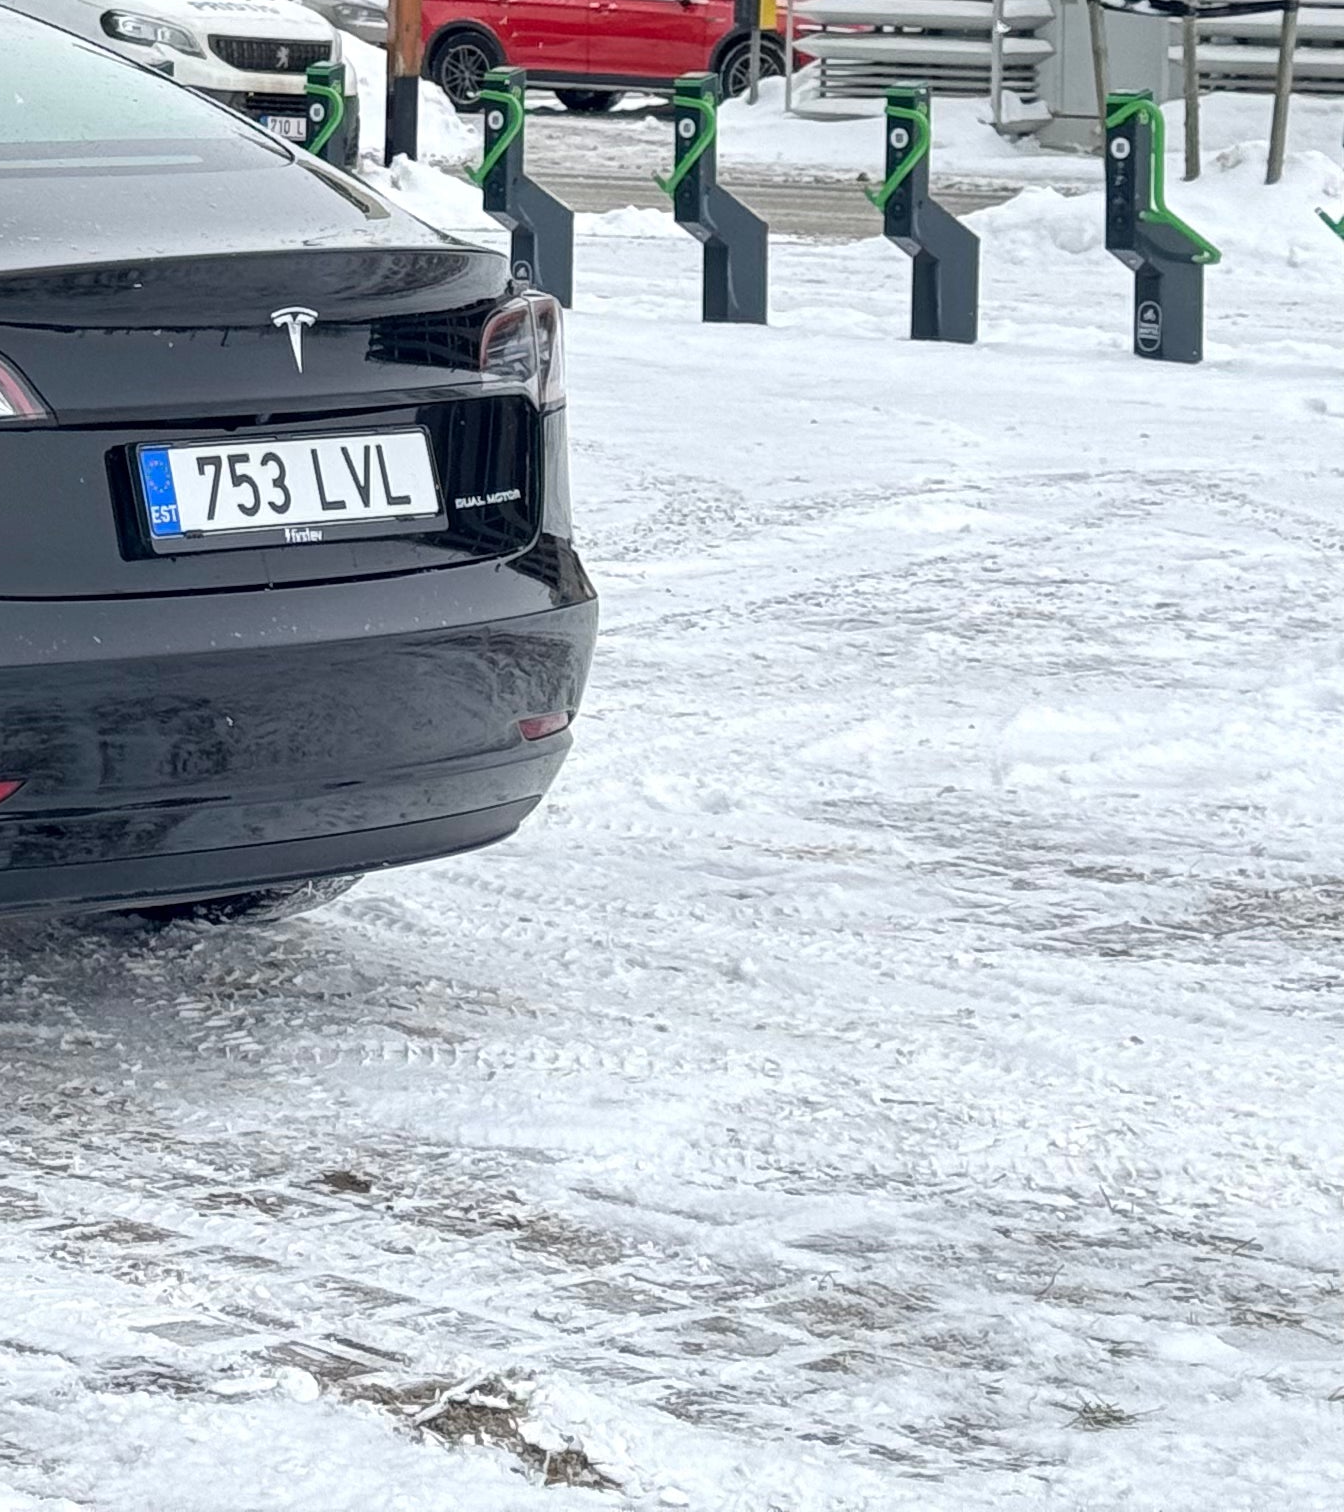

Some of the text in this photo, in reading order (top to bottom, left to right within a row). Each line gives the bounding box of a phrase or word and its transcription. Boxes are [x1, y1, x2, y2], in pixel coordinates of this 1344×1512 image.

[195, 443, 412, 521] 753 LVL
[151, 504, 178, 524] EST
